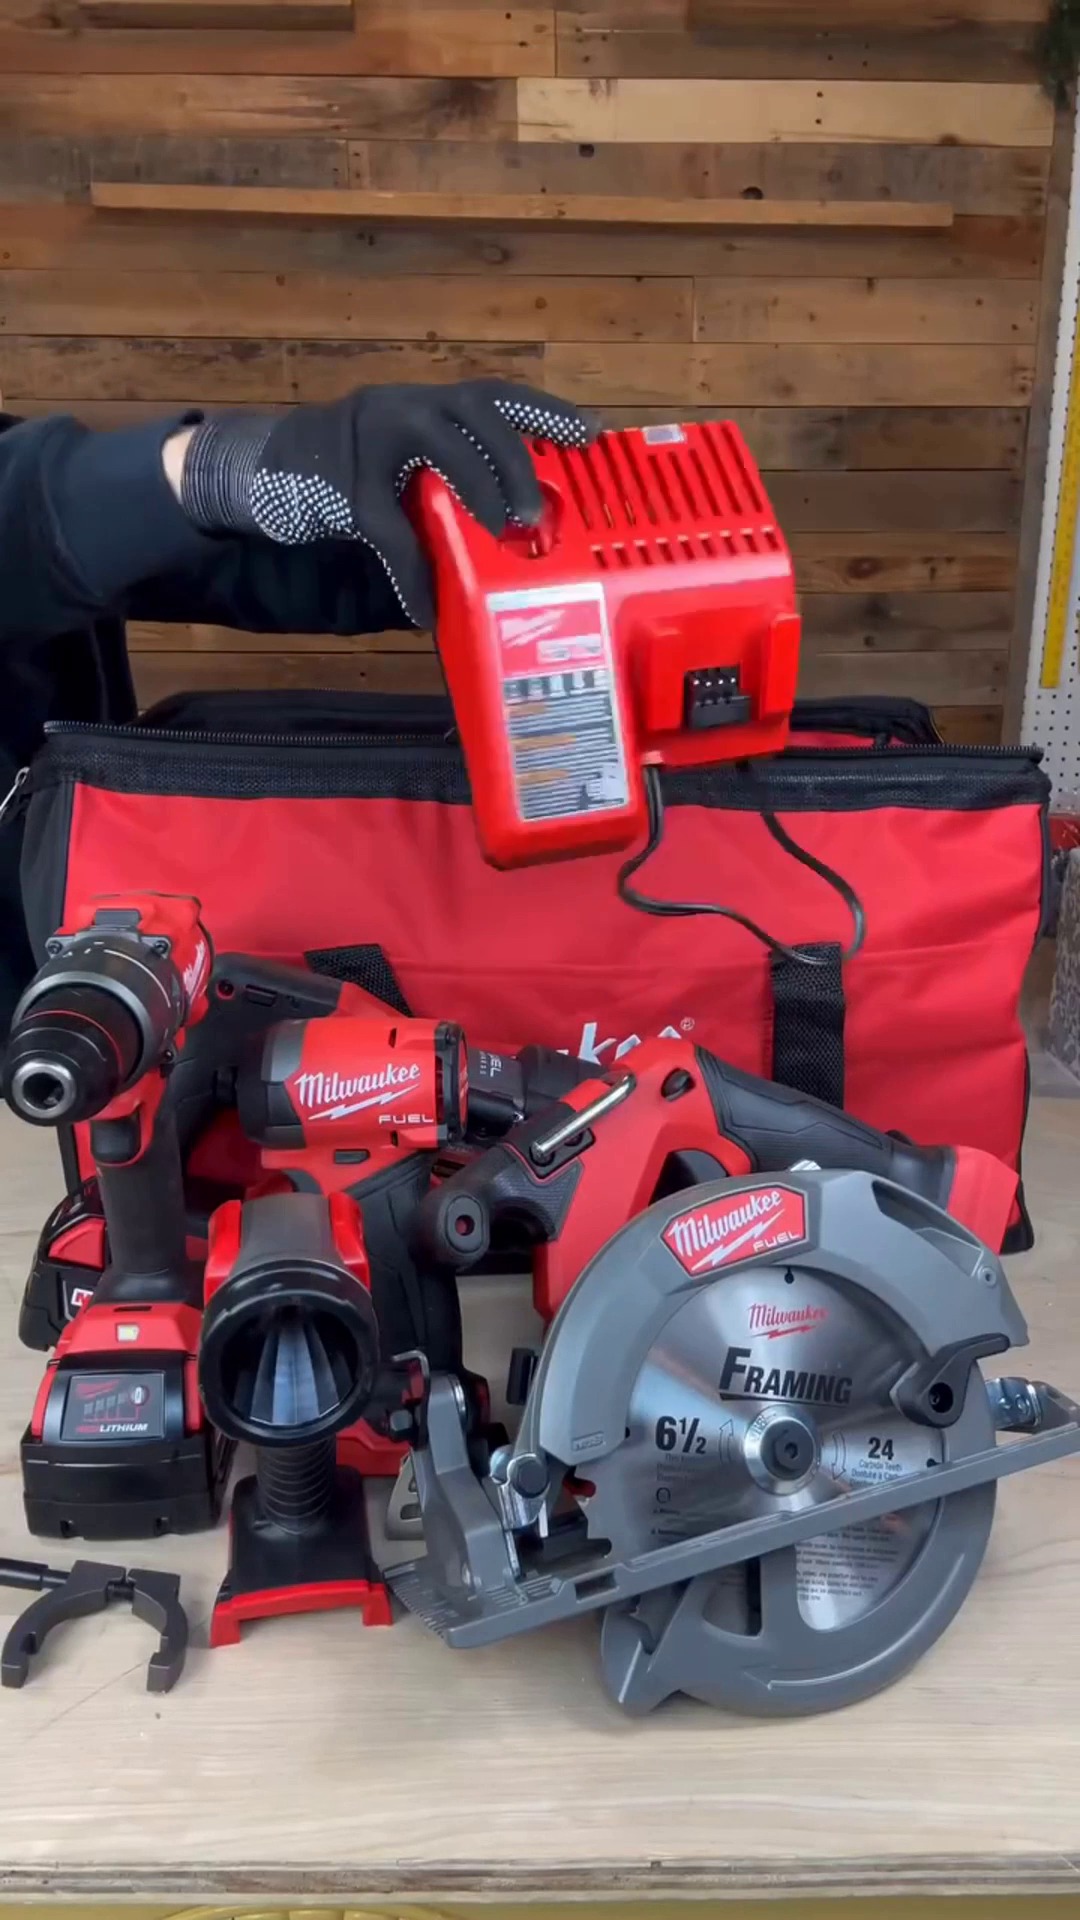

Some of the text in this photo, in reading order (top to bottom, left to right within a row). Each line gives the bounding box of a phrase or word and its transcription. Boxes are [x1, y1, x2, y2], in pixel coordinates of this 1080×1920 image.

[294, 1063, 421, 1109] Milwaukee
[378, 1113, 434, 1125] FUEL
[668, 1191, 782, 1257] Milwaukee
[753, 1231, 801, 1253] FUEL
[747, 1303, 830, 1329] Milwaukee
[867, 1436, 895, 1461] 24
